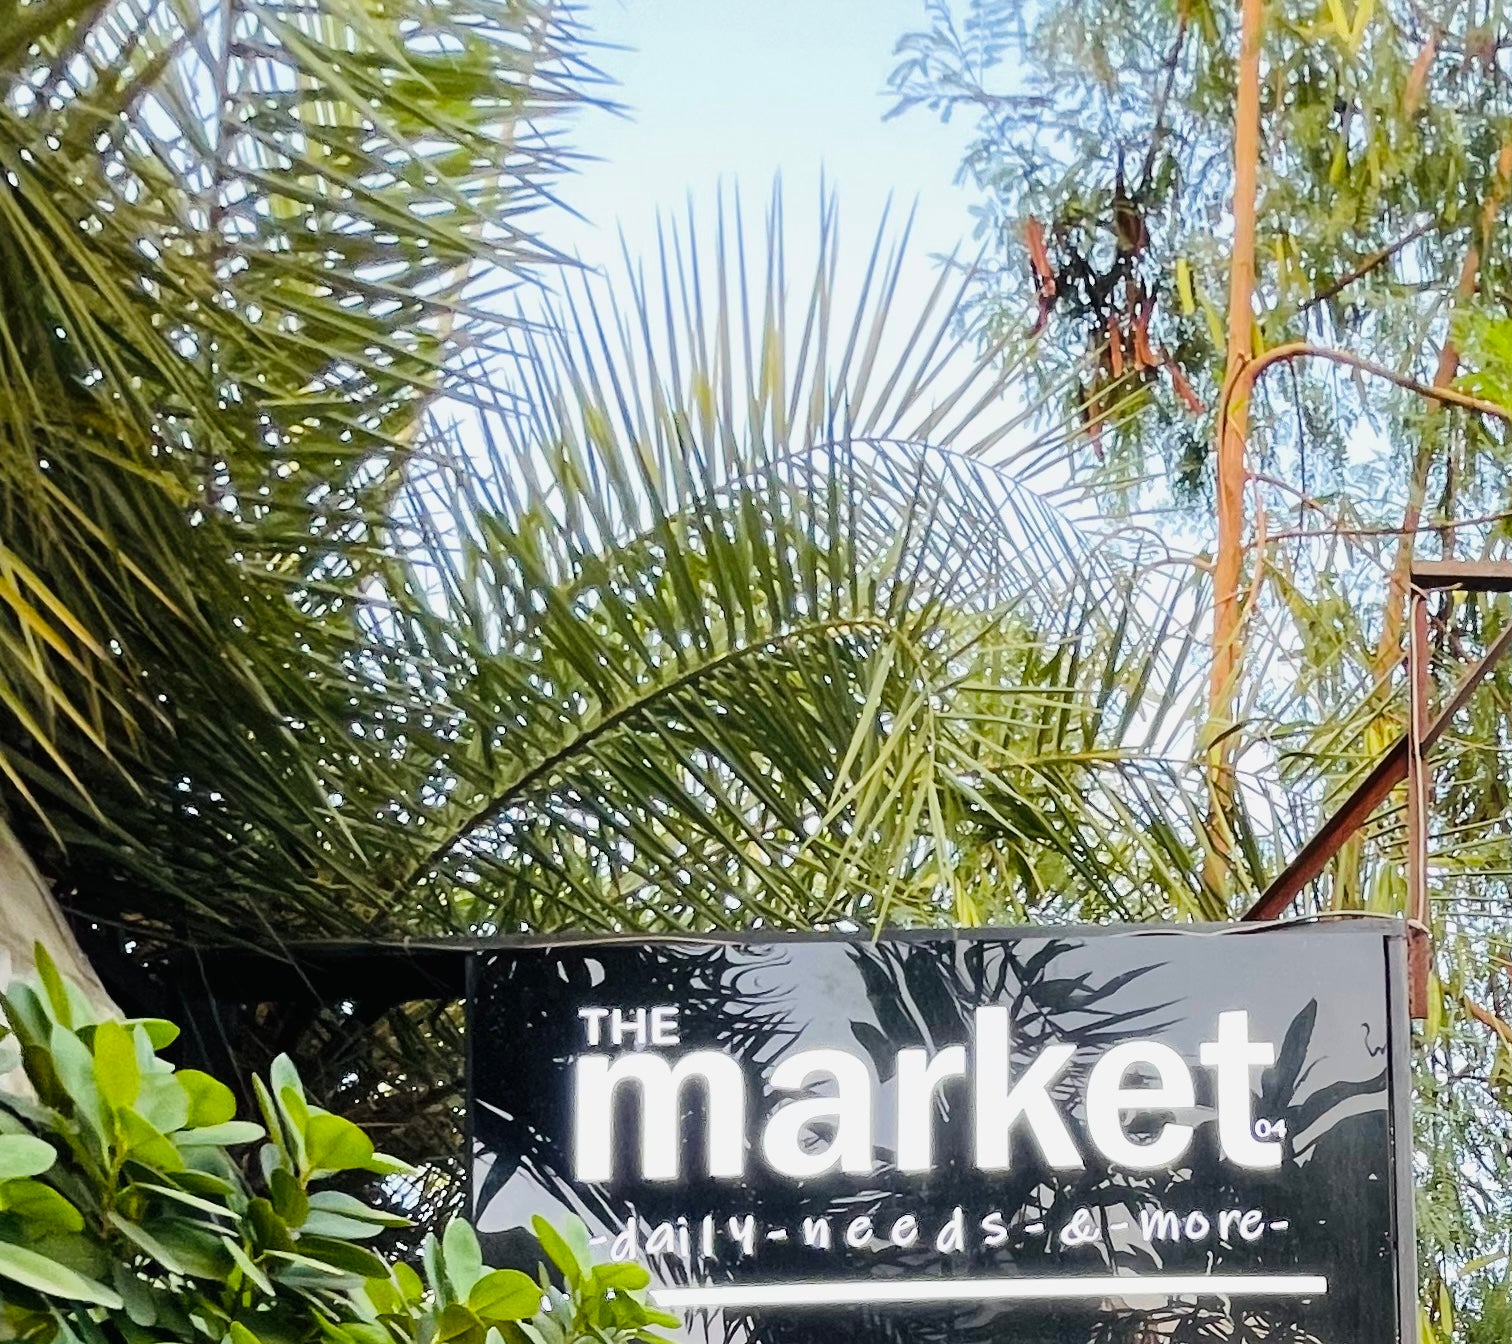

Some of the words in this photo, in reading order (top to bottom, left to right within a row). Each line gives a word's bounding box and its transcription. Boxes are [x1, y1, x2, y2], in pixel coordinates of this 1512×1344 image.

[576, 1006, 681, 1047] THE
[572, 1005, 1283, 1183] market
[1254, 1118, 1288, 1138] 04
